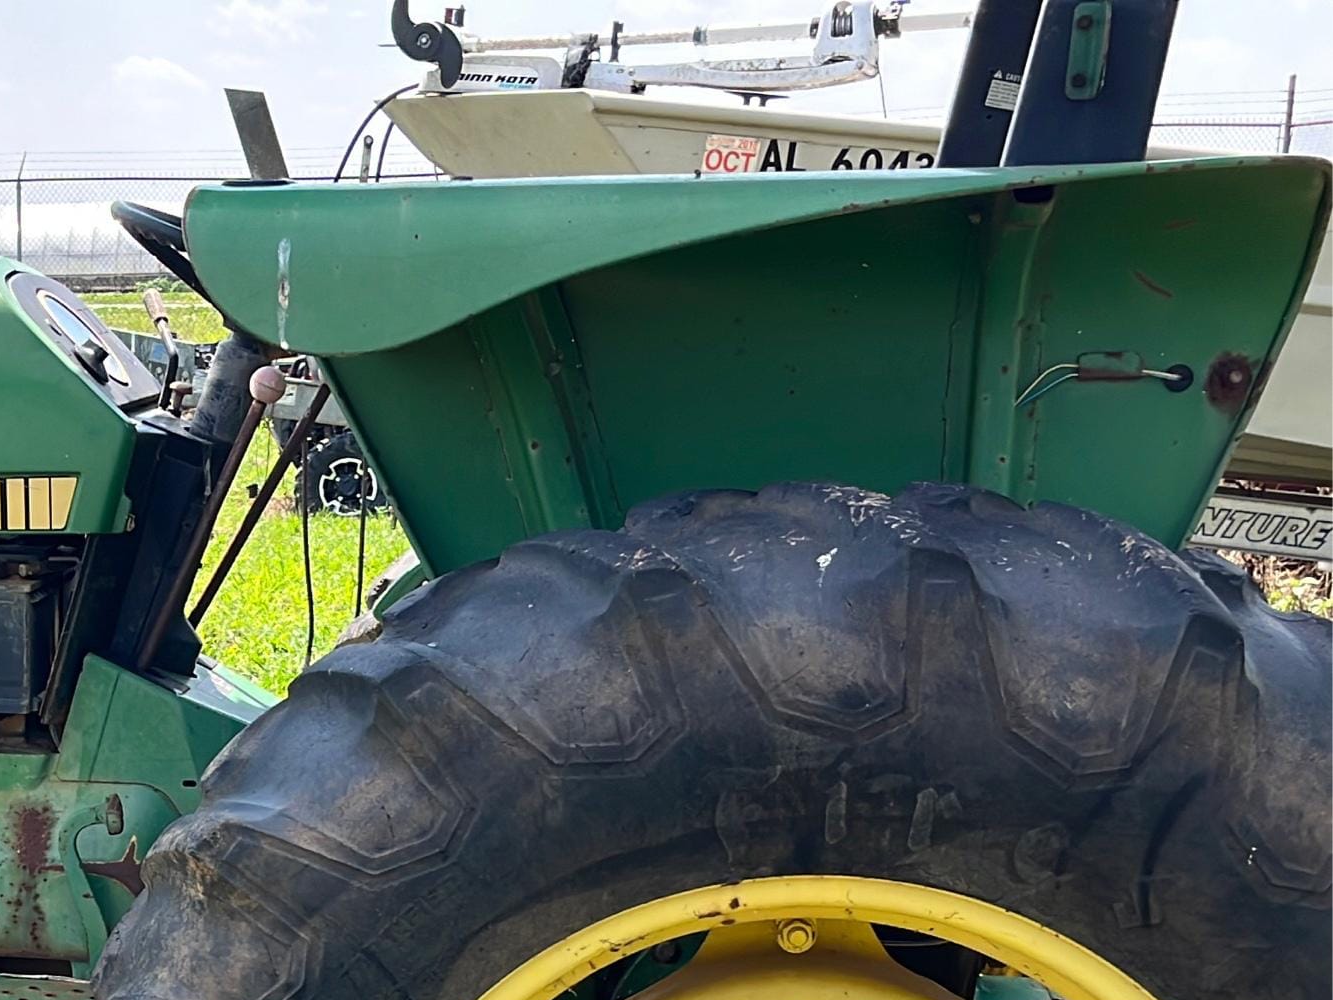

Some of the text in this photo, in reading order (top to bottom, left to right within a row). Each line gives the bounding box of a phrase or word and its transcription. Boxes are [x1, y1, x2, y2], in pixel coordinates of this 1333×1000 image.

[495, 75, 538, 84] KOTA
[705, 149, 756, 172] OCT
[759, 139, 807, 171] AL
[1193, 506, 1333, 550] NTURE
